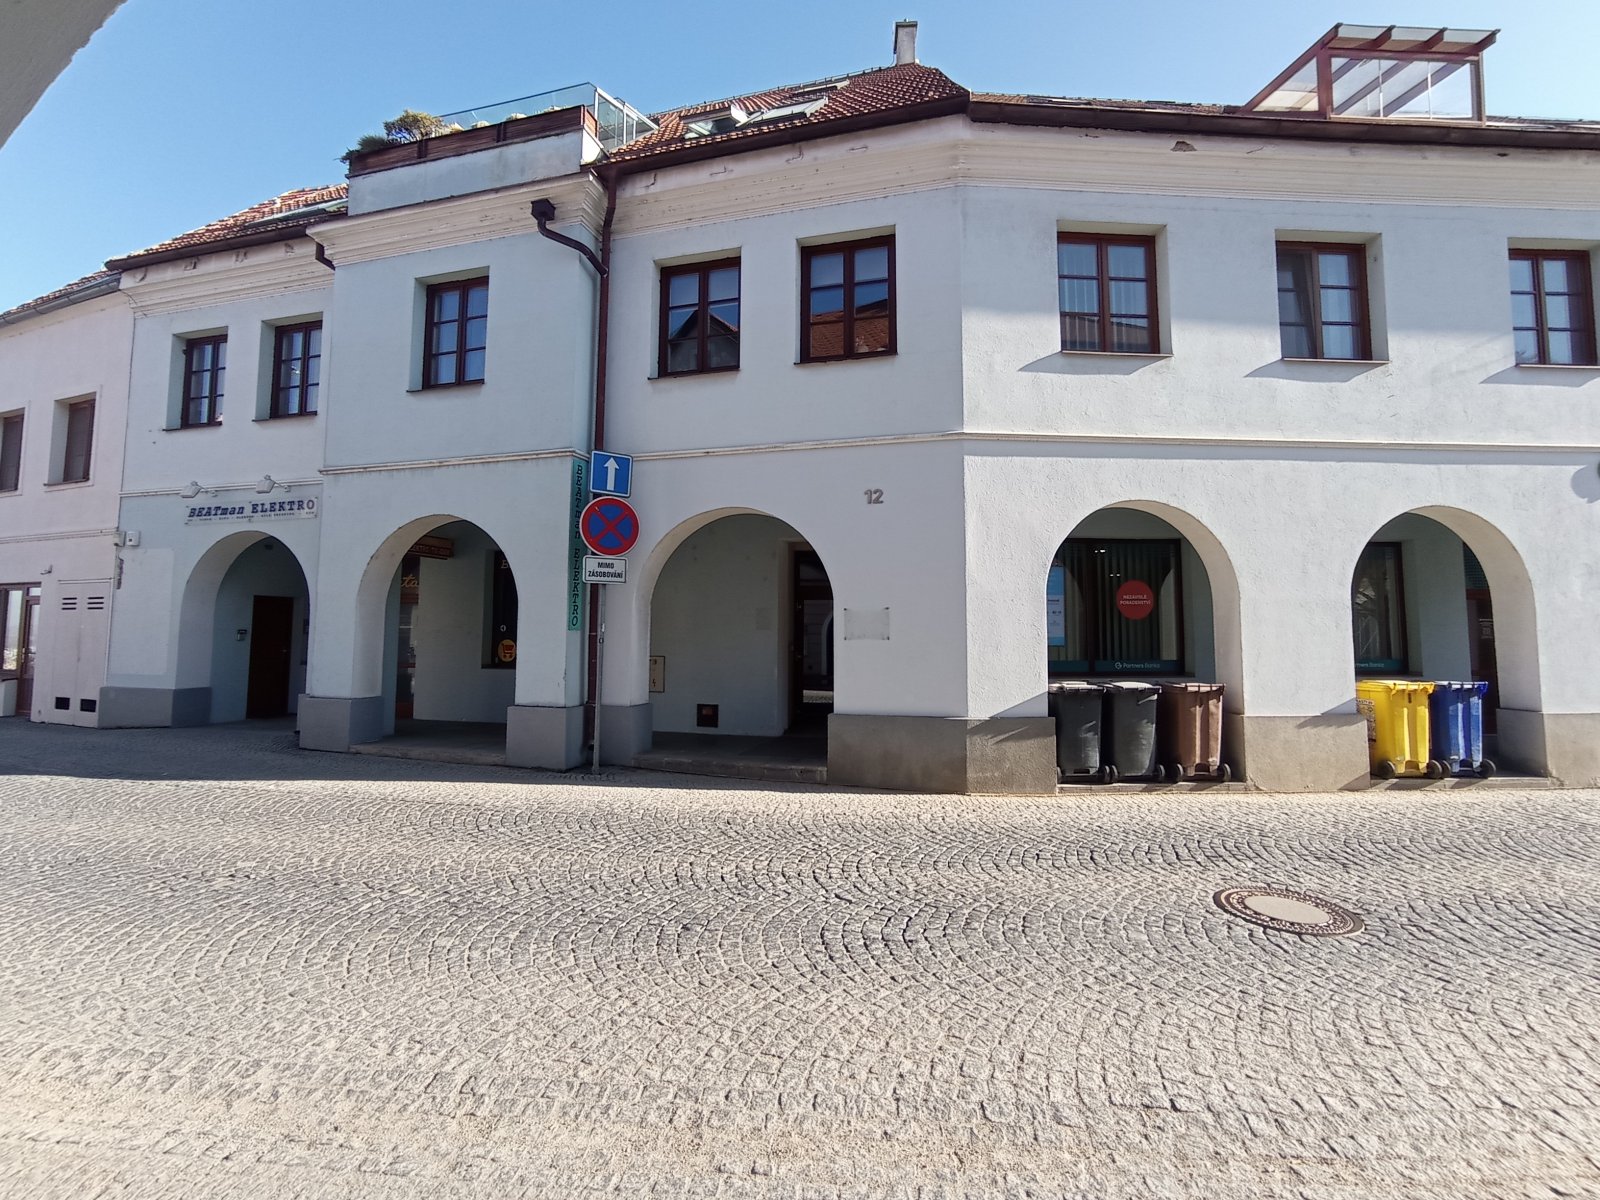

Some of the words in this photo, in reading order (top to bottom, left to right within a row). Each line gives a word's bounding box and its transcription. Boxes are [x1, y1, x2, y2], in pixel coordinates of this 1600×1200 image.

[864, 488, 884, 504] 12
[188, 506, 245, 518] BEATman
[251, 499, 315, 514] ELEKTRO
[588, 569, 624, 578] ZÁSOBOVÁNÍ
[572, 548, 580, 627] ELEKTRO
